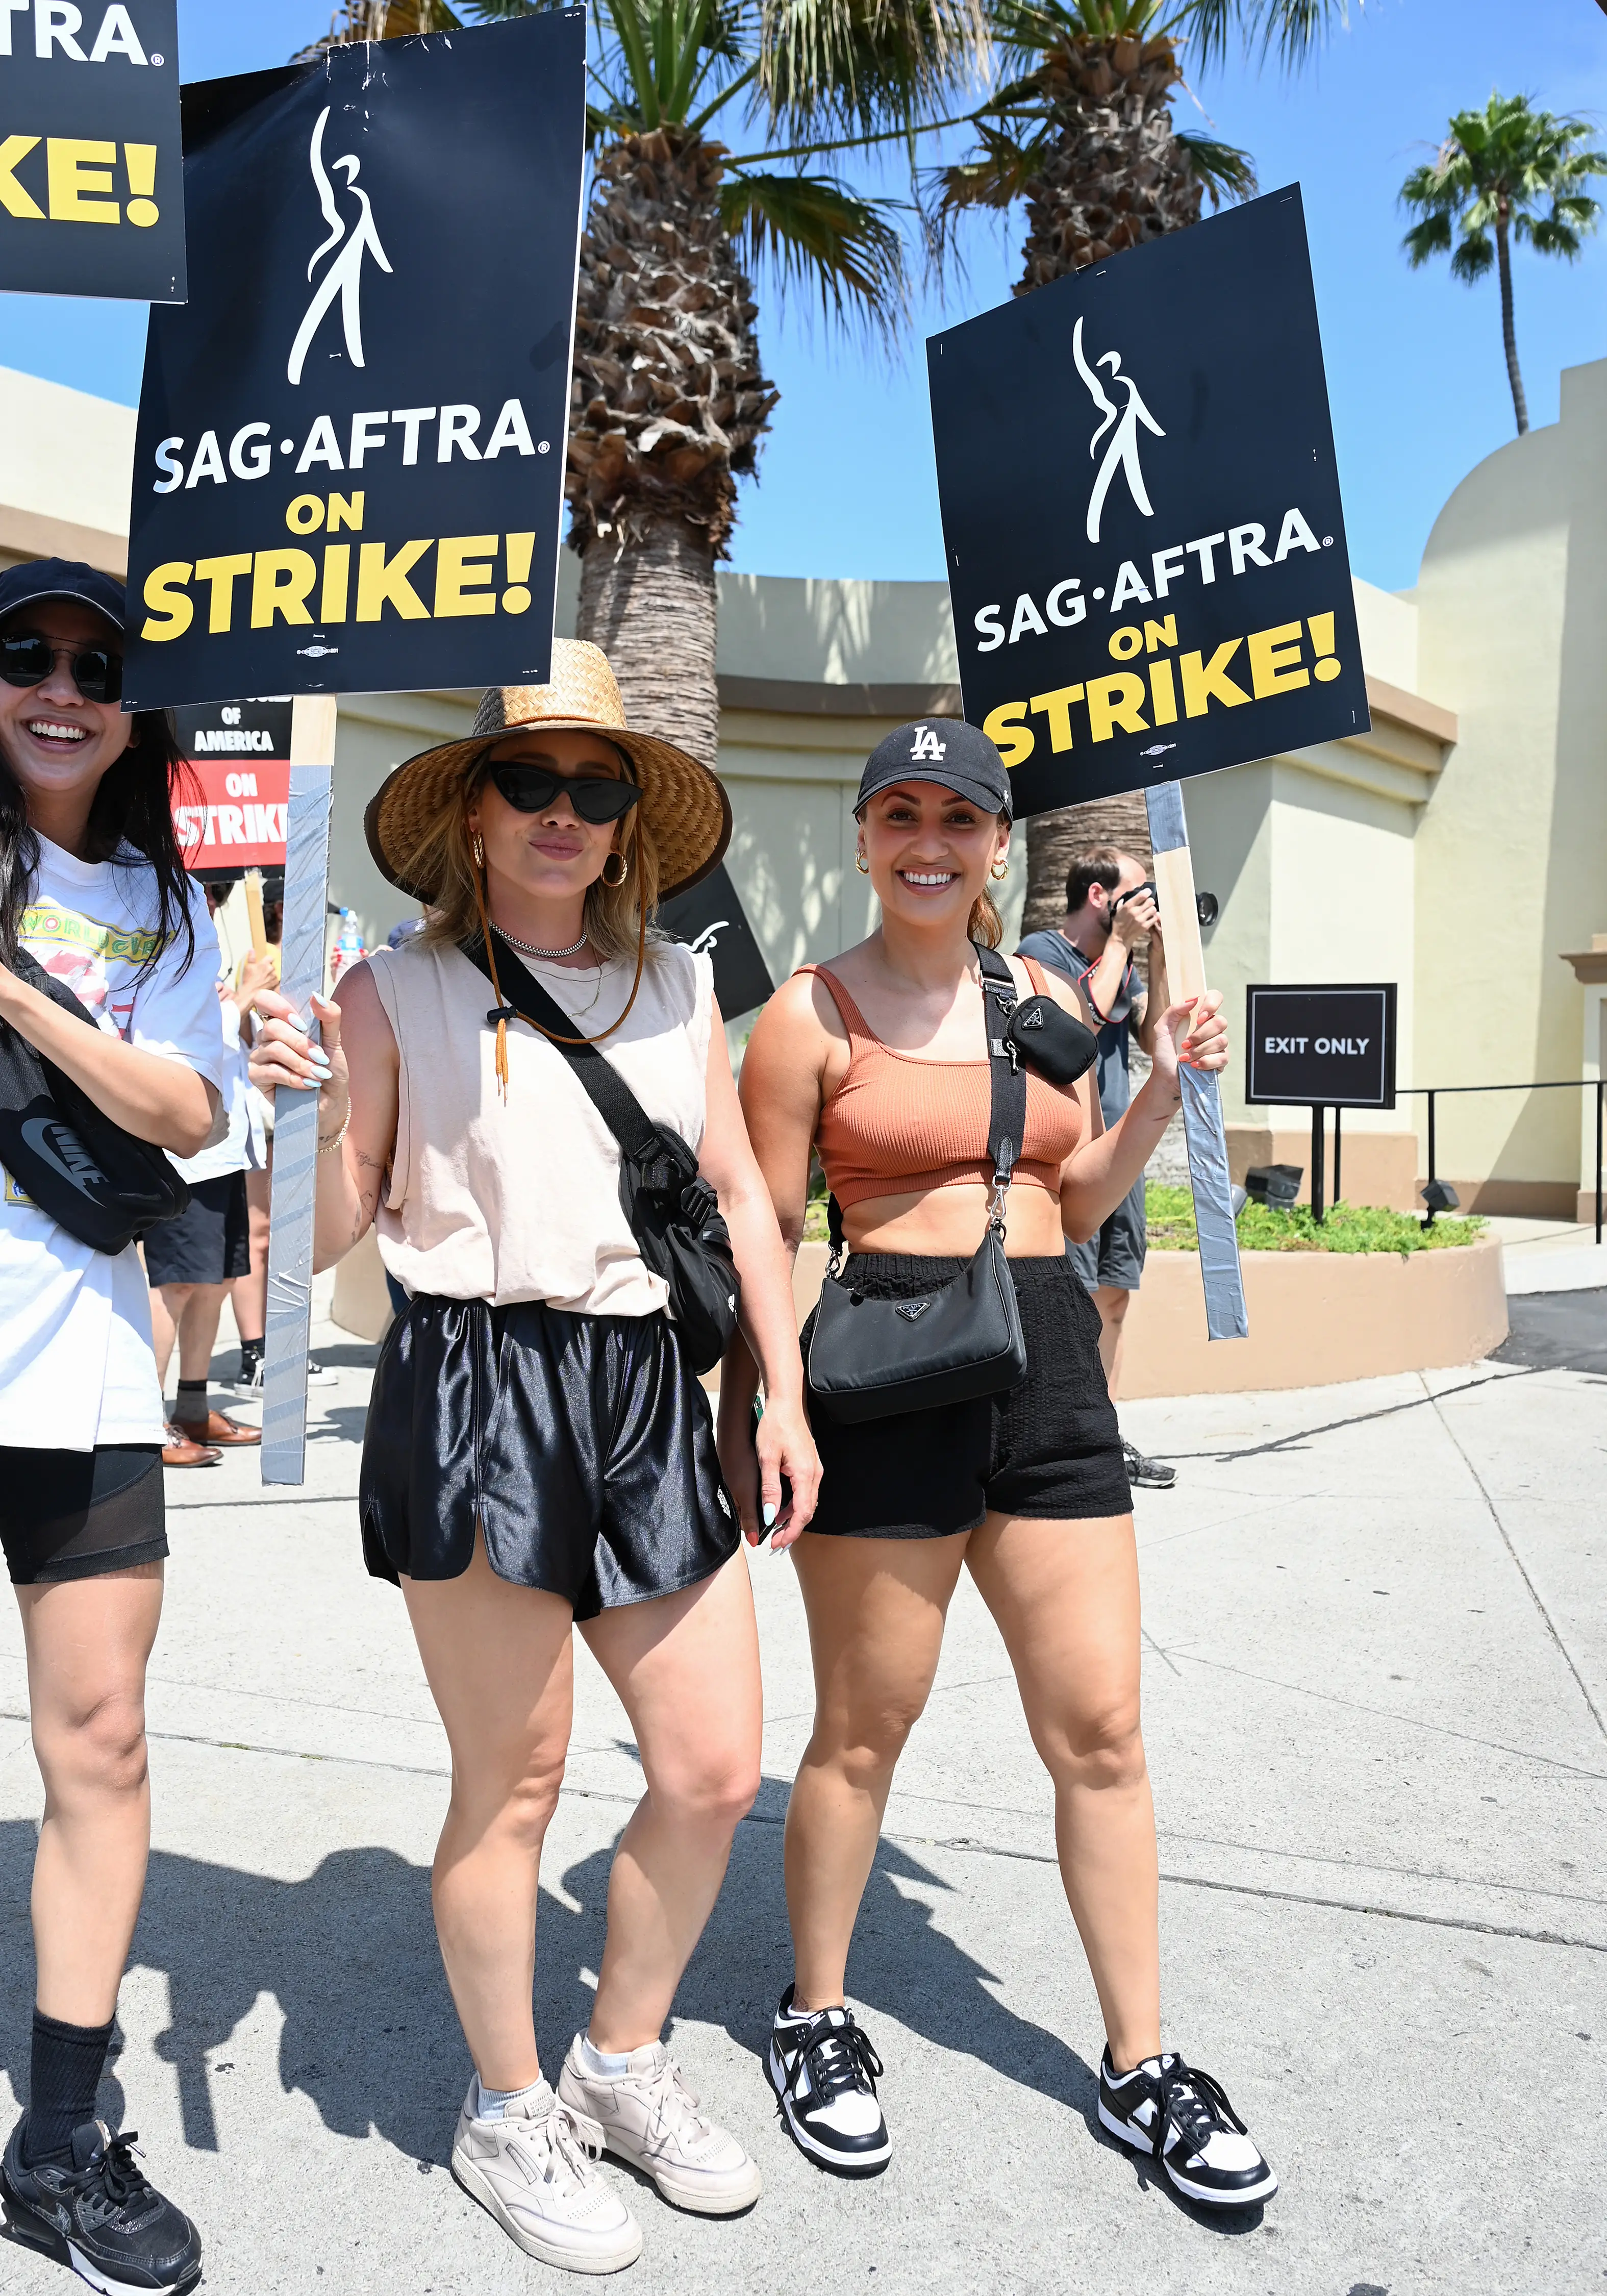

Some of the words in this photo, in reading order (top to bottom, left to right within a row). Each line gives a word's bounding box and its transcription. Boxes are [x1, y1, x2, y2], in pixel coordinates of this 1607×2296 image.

[286, 492, 365, 535] ON
[140, 532, 536, 642] STRIKE!
[1108, 614, 1178, 661] ON
[983, 611, 1342, 769] STRIKE!
[221, 707, 241, 725] OF
[194, 730, 274, 752] AMERICA
[910, 726, 946, 761] LA
[225, 772, 258, 798] ON
[22, 915, 110, 949] WORLD
[1265, 1037, 1309, 1054] EXIT
[1315, 1038, 1369, 1055] ONLY
[50, 1126, 110, 1186] NIKE
